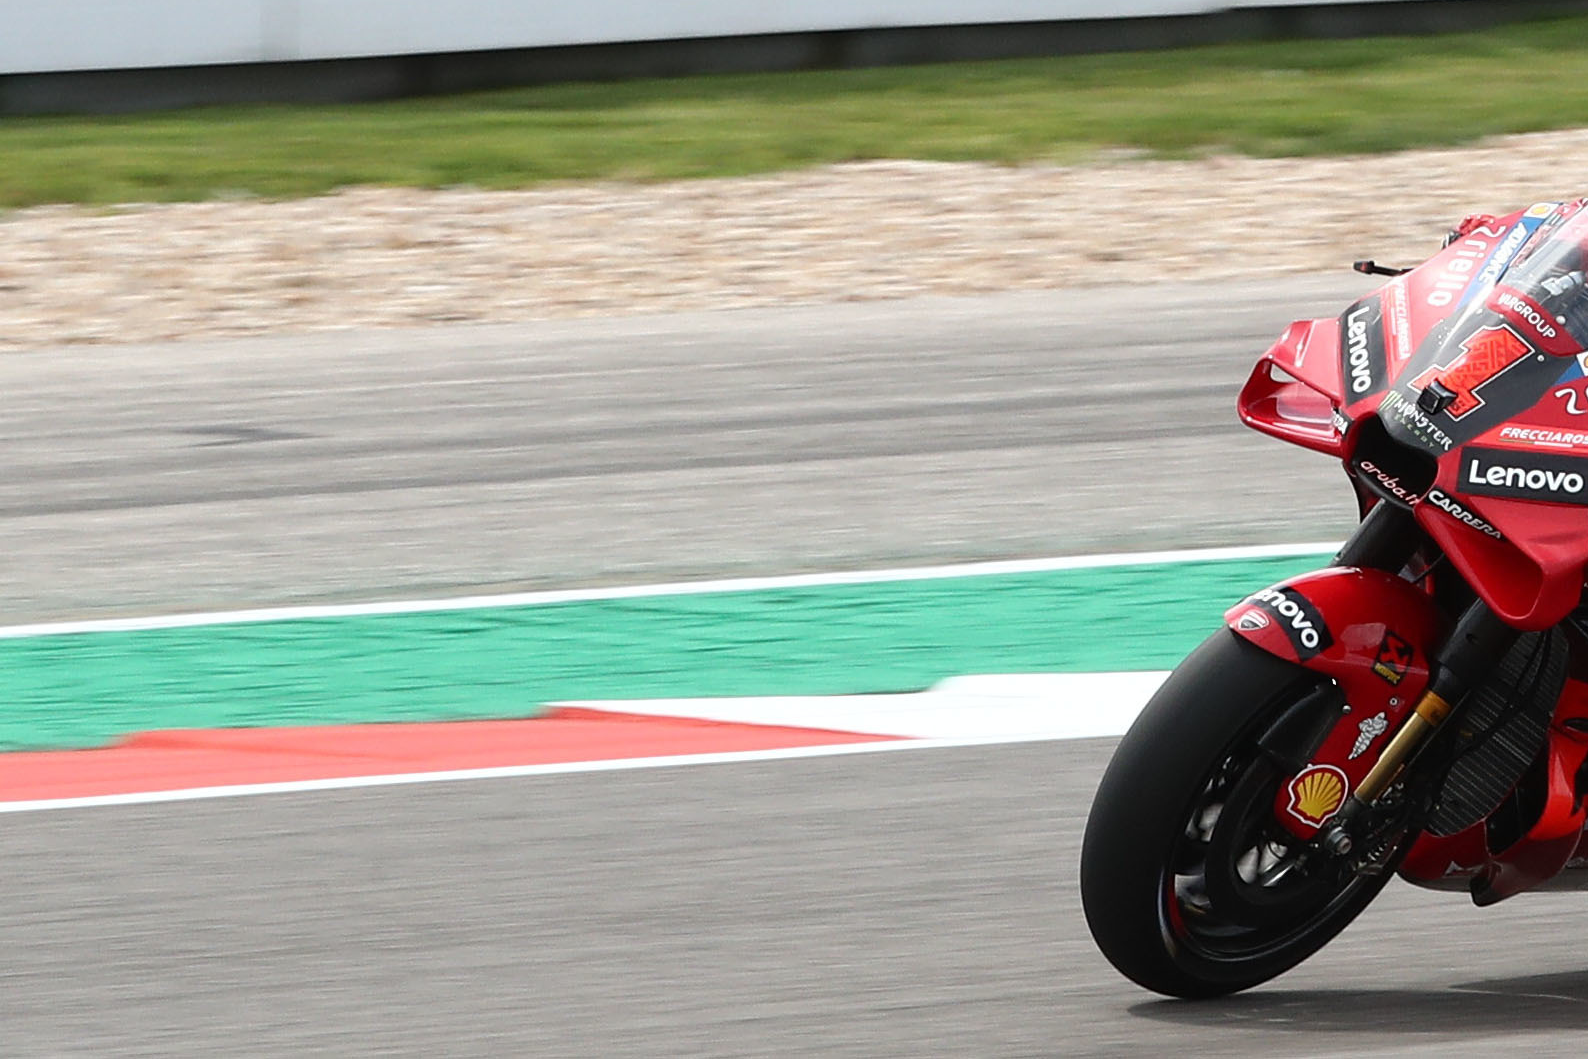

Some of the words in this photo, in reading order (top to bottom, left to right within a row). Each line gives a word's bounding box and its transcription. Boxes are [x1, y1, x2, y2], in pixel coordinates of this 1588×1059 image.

[1346, 306, 1372, 394] Lenovo
[1394, 398, 1453, 451] MONSTER
[1468, 459, 1584, 494] Lenovo
[1428, 490, 1501, 539] CARRERA
[1252, 589, 1319, 648] enovo
